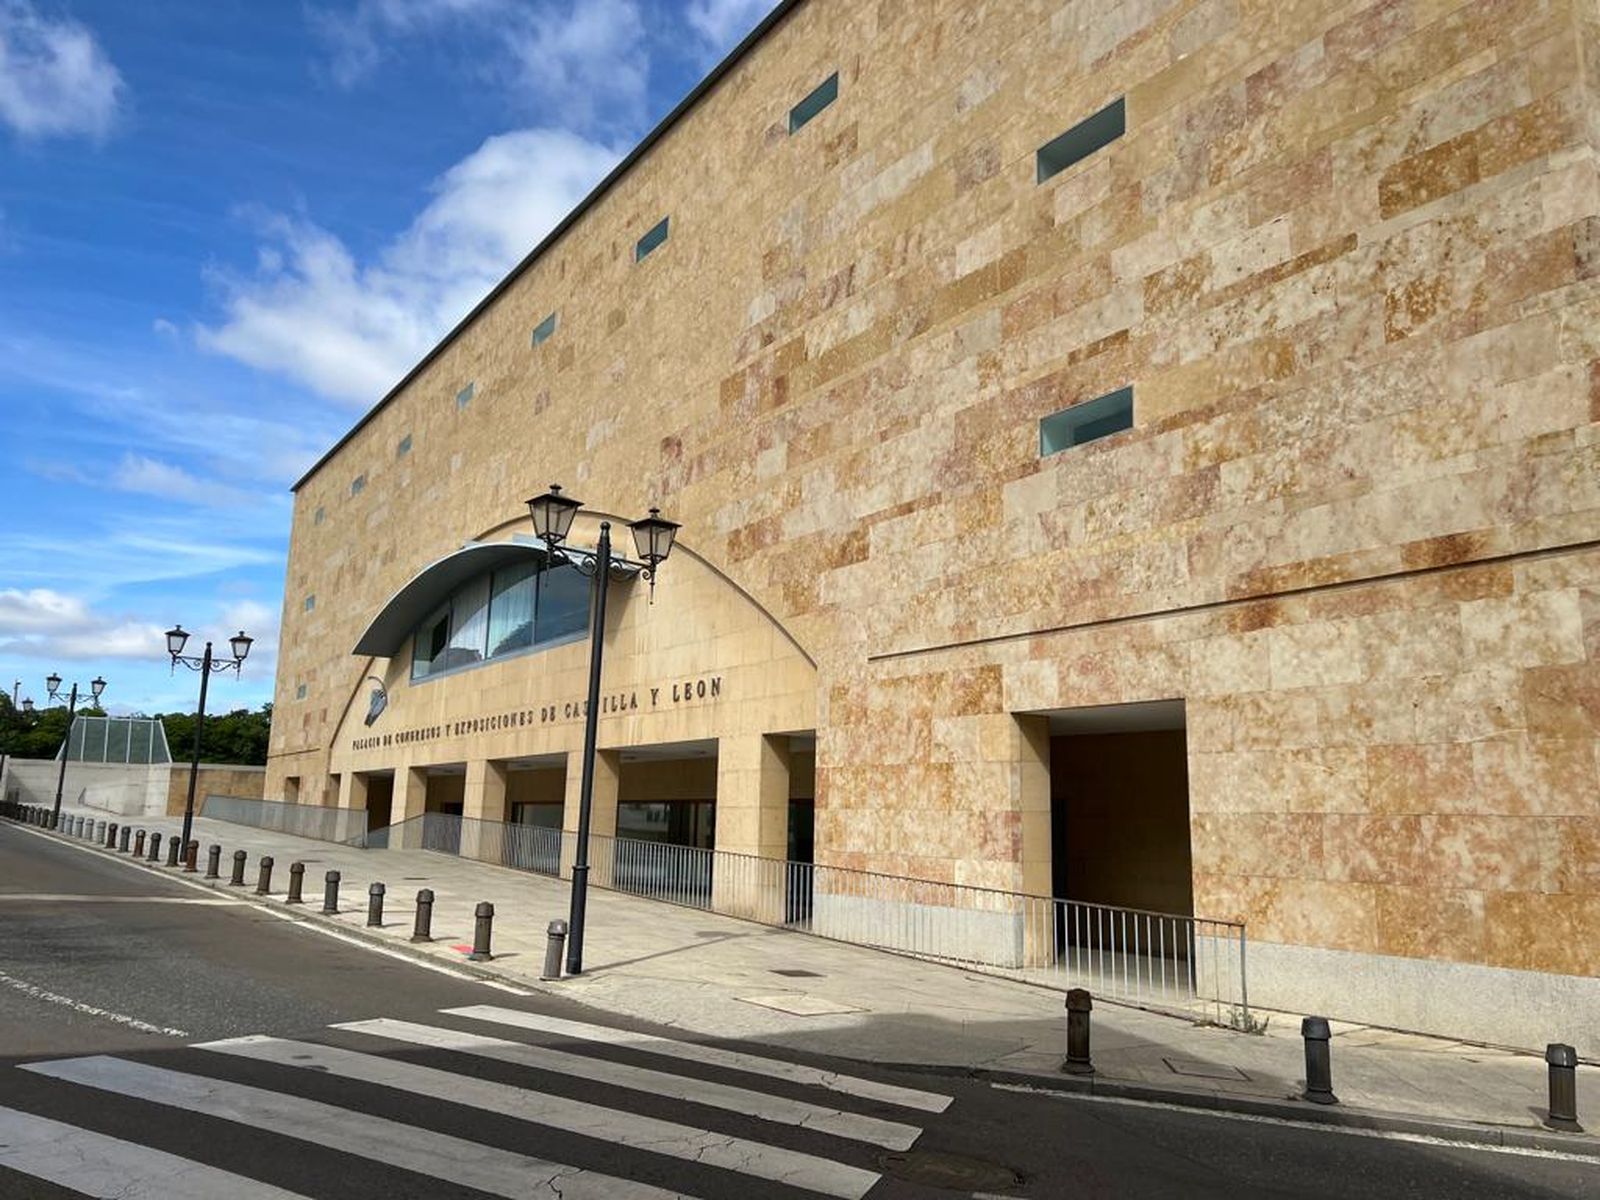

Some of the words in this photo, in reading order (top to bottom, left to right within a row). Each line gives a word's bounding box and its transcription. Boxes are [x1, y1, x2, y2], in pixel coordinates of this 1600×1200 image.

[352, 736, 381, 750] PALACIO
[383, 734, 392, 747] DE
[395, 726, 441, 744] CONGRESOS
[445, 724, 451, 737] Y
[454, 710, 534, 736] EXPOSICIONES
[541, 706, 556, 723] DE
[650, 688, 660, 706] Y
[672, 676, 722, 703] LEON
